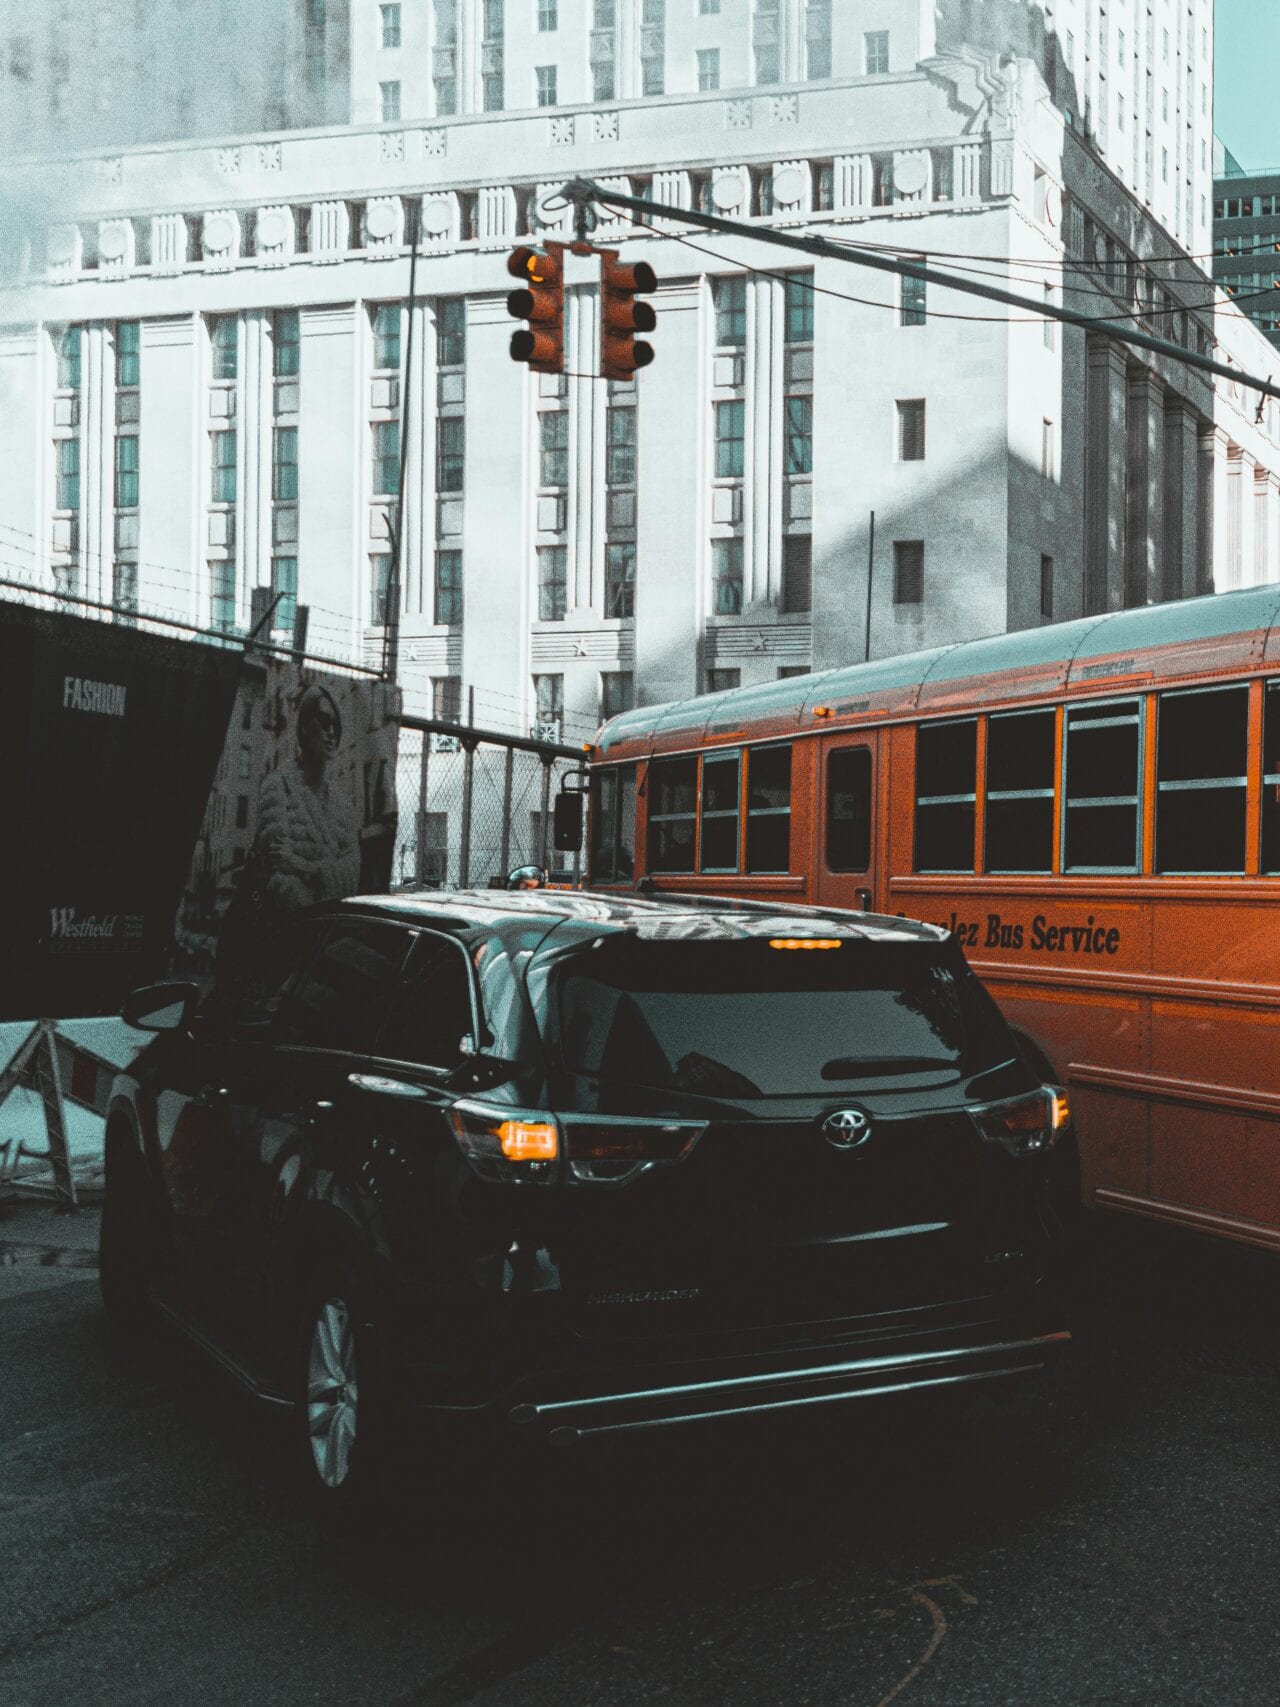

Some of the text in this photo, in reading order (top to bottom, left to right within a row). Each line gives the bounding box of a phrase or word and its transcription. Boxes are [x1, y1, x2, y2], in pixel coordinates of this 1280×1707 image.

[63, 676, 127, 716] FASHION
[48, 905, 118, 938] Westfield
[984, 913, 1024, 950] Bus
[1030, 914, 1120, 955] Service
